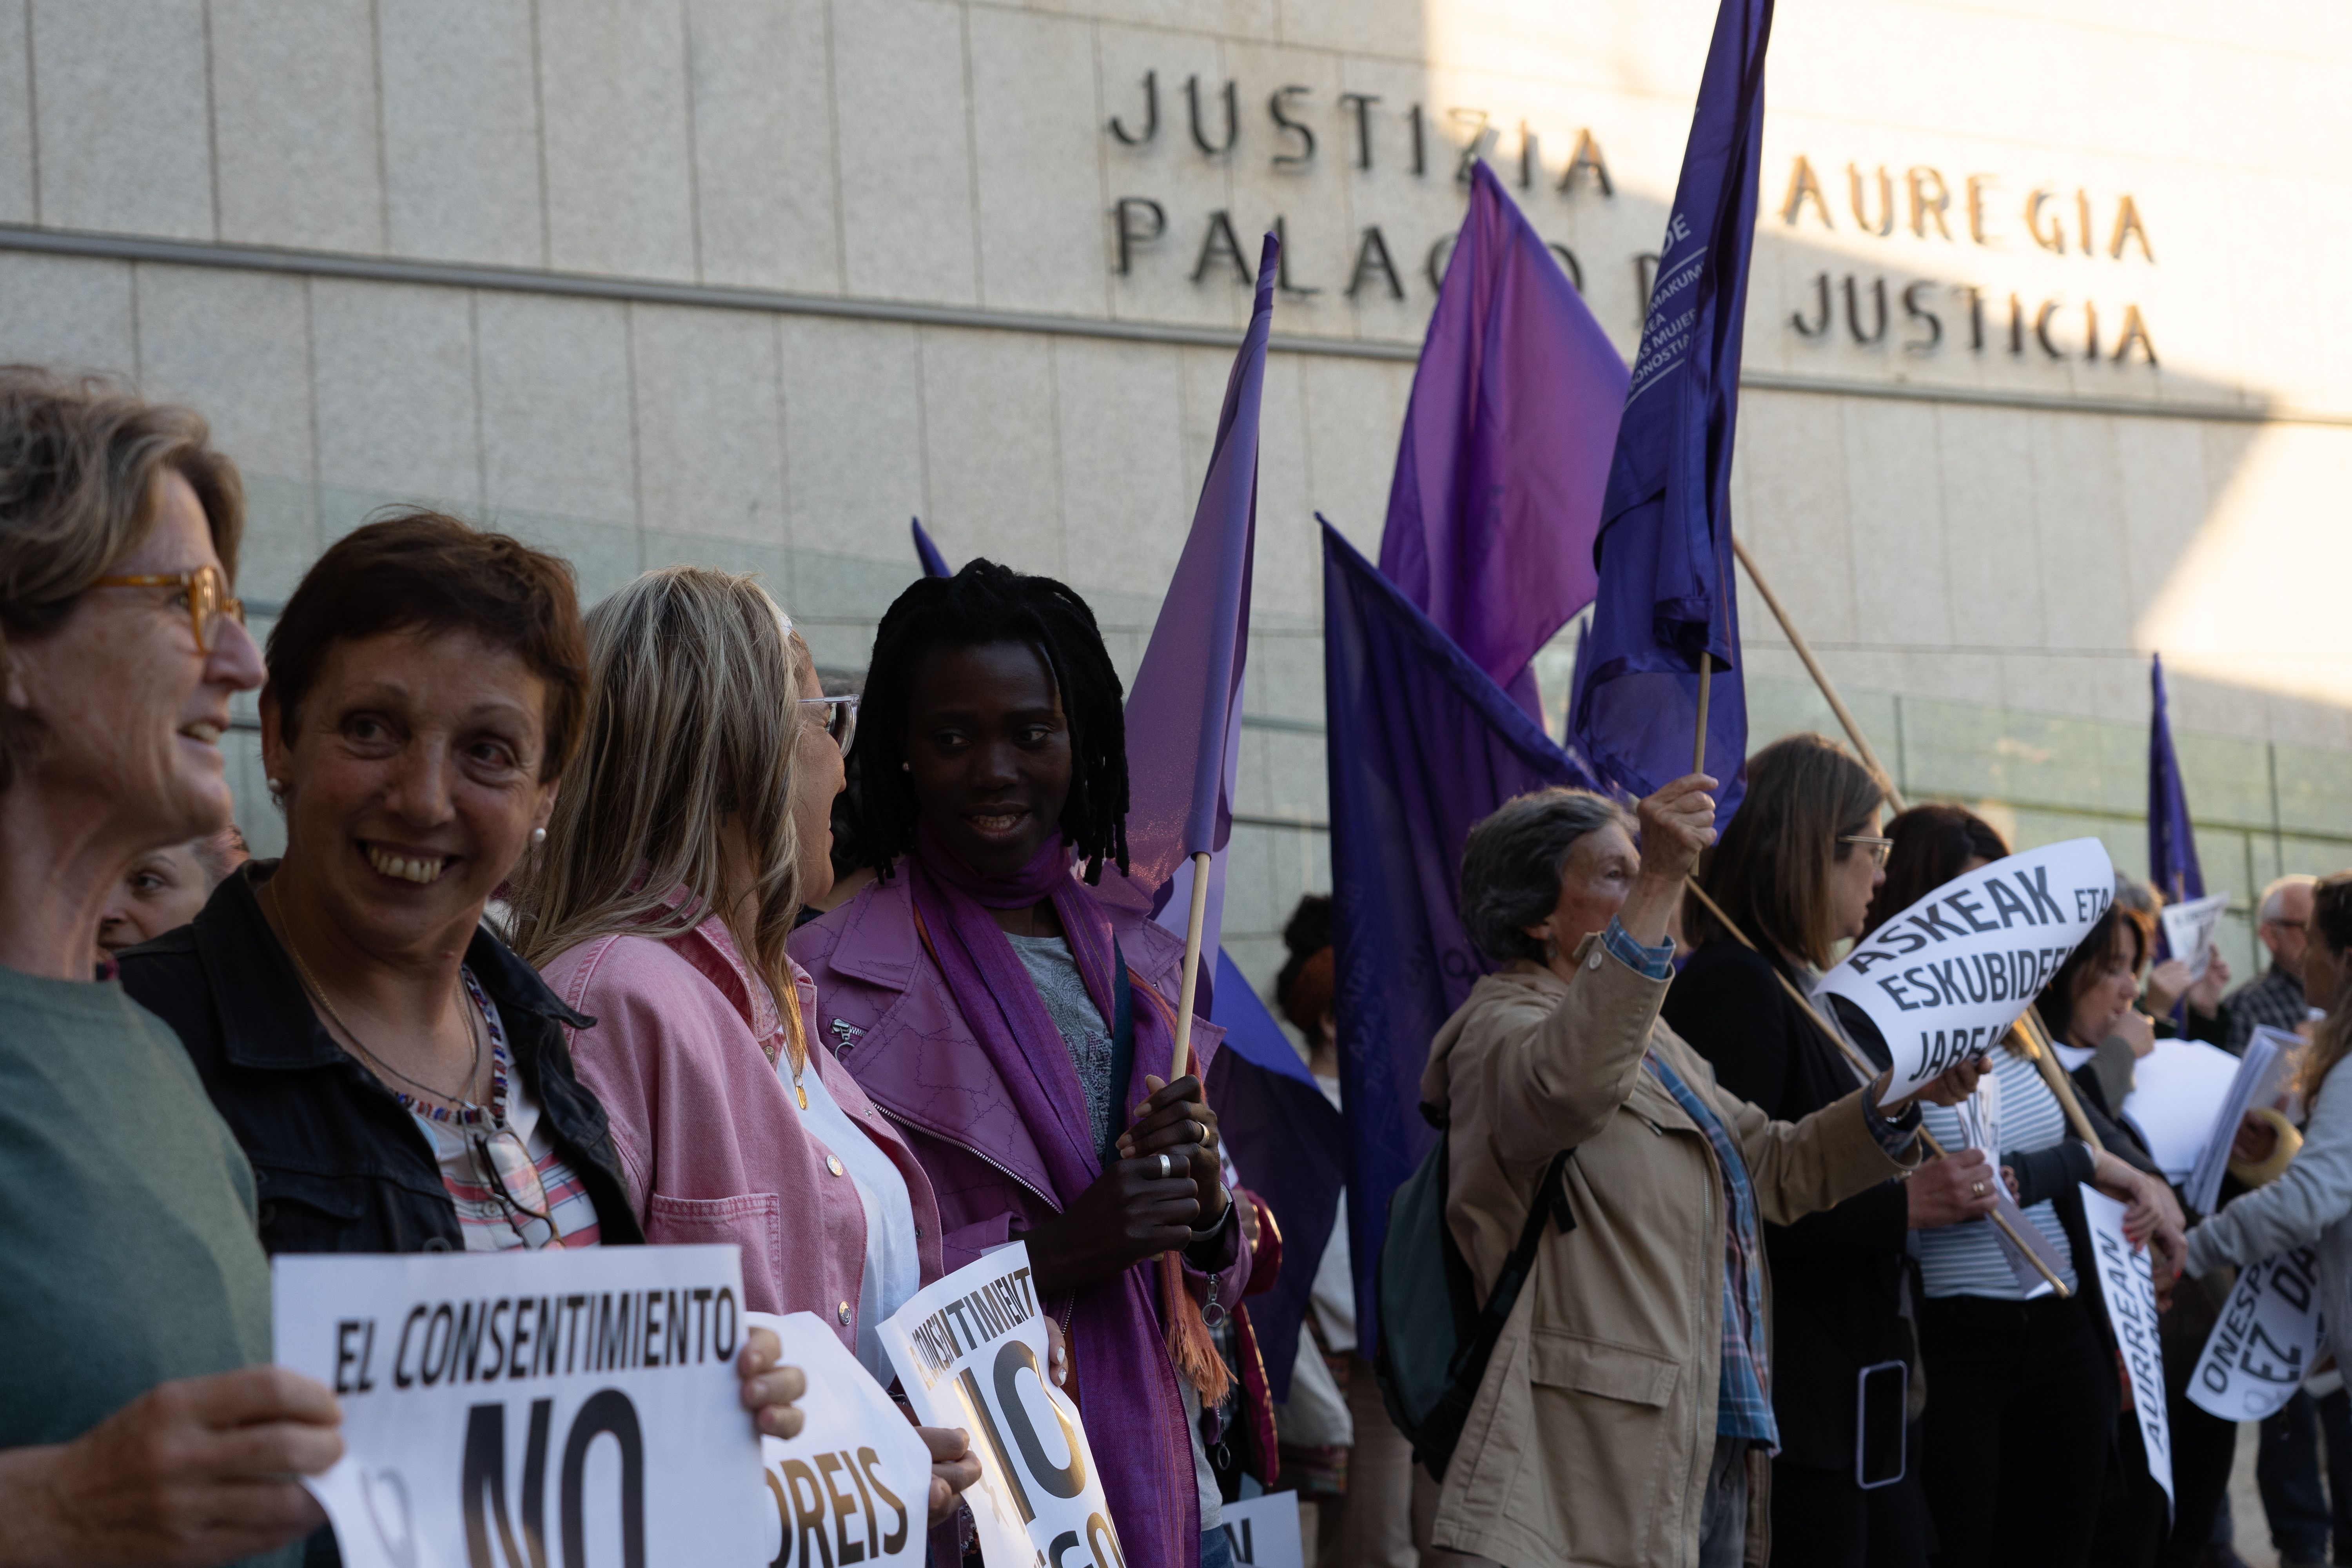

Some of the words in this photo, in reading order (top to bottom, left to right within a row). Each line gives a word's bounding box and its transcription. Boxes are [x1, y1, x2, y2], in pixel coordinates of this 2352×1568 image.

[1109, 71, 1612, 196] JUSTIZIA
[1780, 153, 2157, 264] AUREGIA
[1646, 260, 1704, 319] MAKUM
[1788, 273, 2159, 364] JUSTICIA
[1847, 866, 2066, 976] ASKEAK
[2074, 887, 2110, 923] ETA
[334, 1319, 377, 1394] EL
[394, 1286, 736, 1390] CONSENTIMIENTO
[911, 1266, 1035, 1383] CONSENTIMIENT
[2096, 1227, 2164, 1455] AURREAN
[462, 1388, 645, 1568] NO
